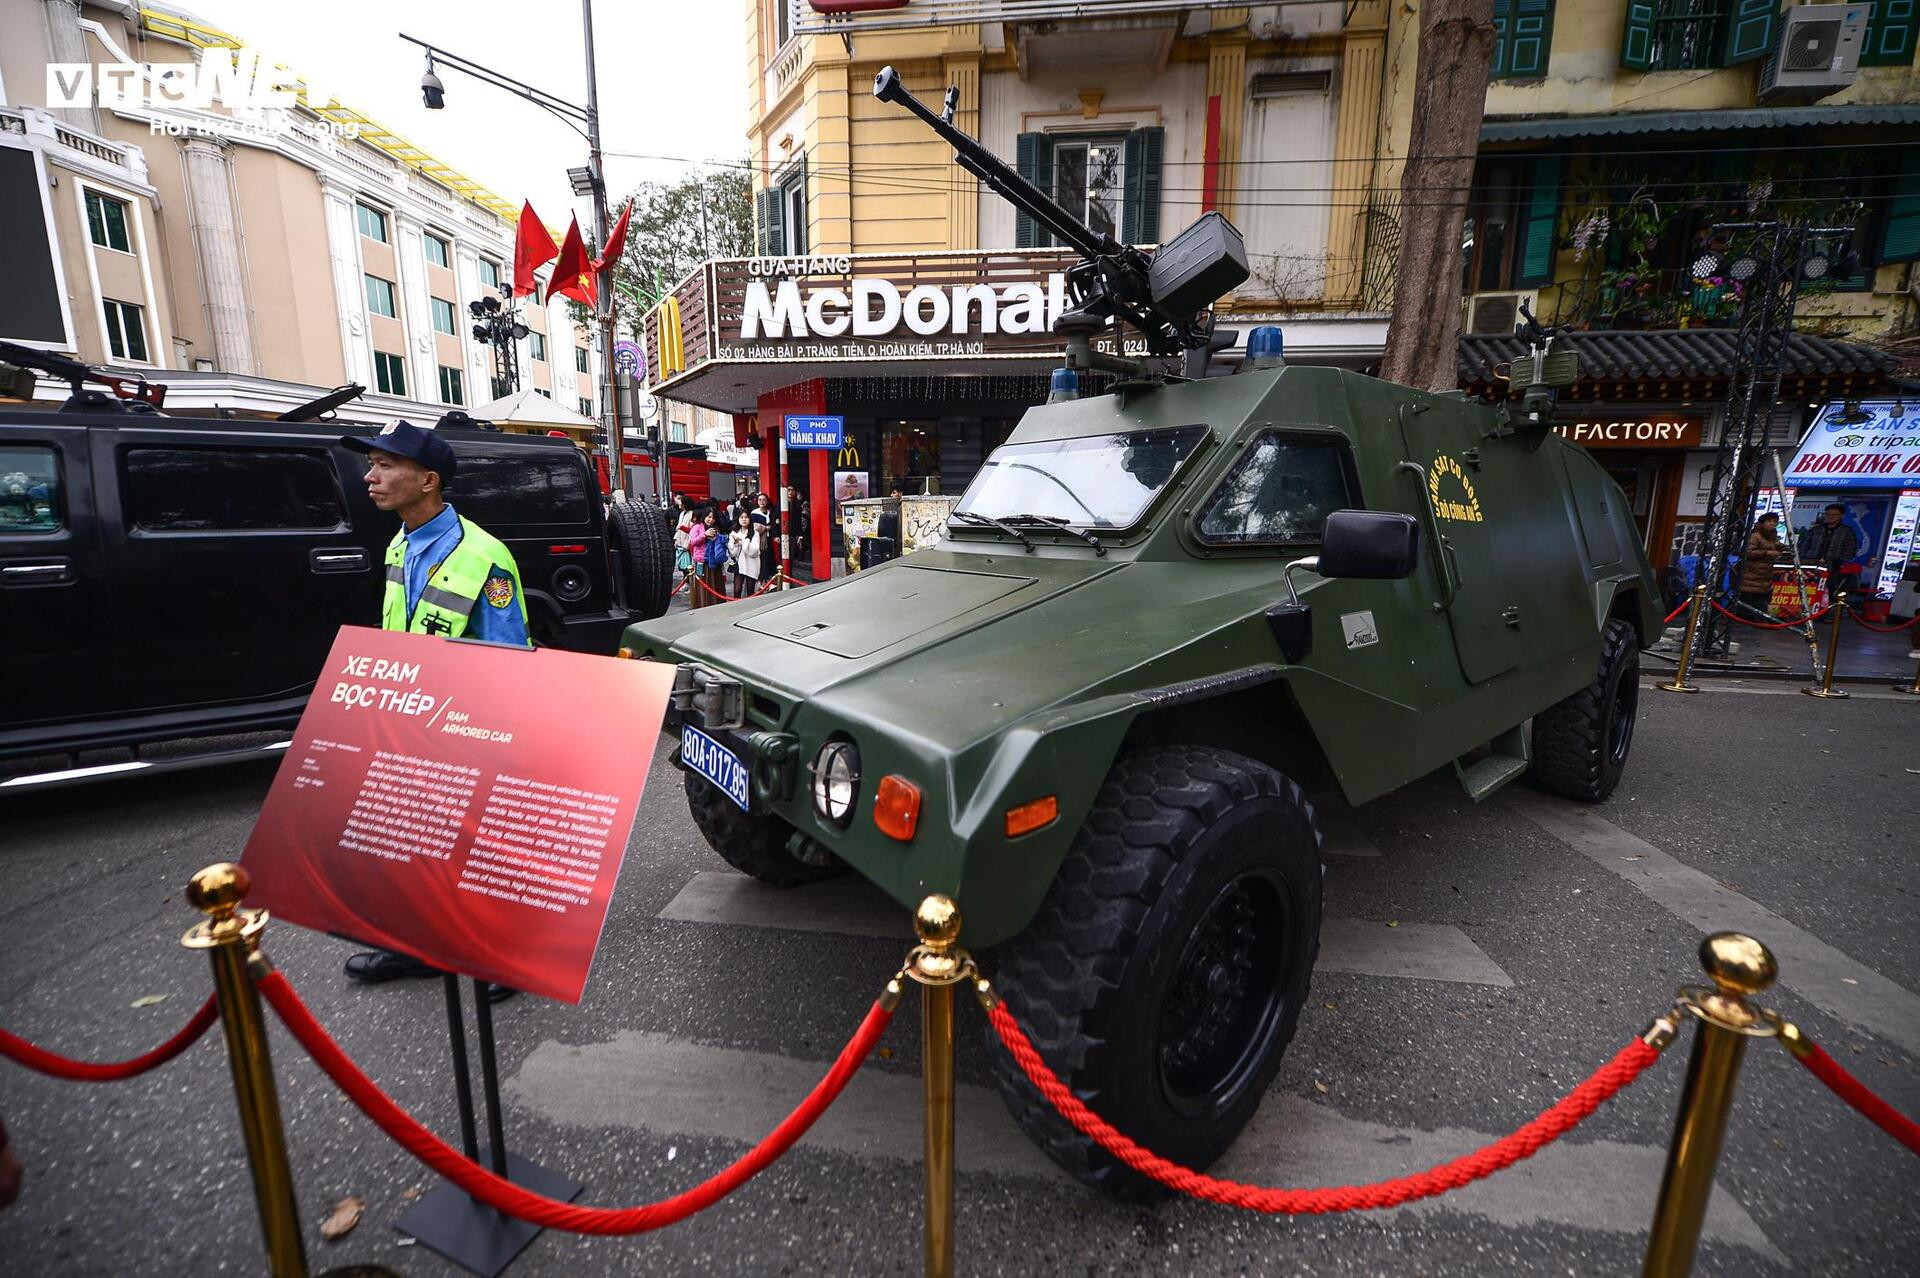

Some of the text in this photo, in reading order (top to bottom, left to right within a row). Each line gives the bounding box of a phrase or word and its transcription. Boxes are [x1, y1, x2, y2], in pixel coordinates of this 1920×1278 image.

[734, 347, 745, 359] 02
[790, 430, 838, 445] HÀNG KHAY
[1574, 422, 1688, 440] FACTORY
[1793, 453, 1902, 473] BOOKING
[341, 655, 419, 683] XE RAM
[330, 682, 434, 715] BỌC THÉP
[446, 710, 468, 722] RAM
[441, 723, 512, 742] ARMORED CAR
